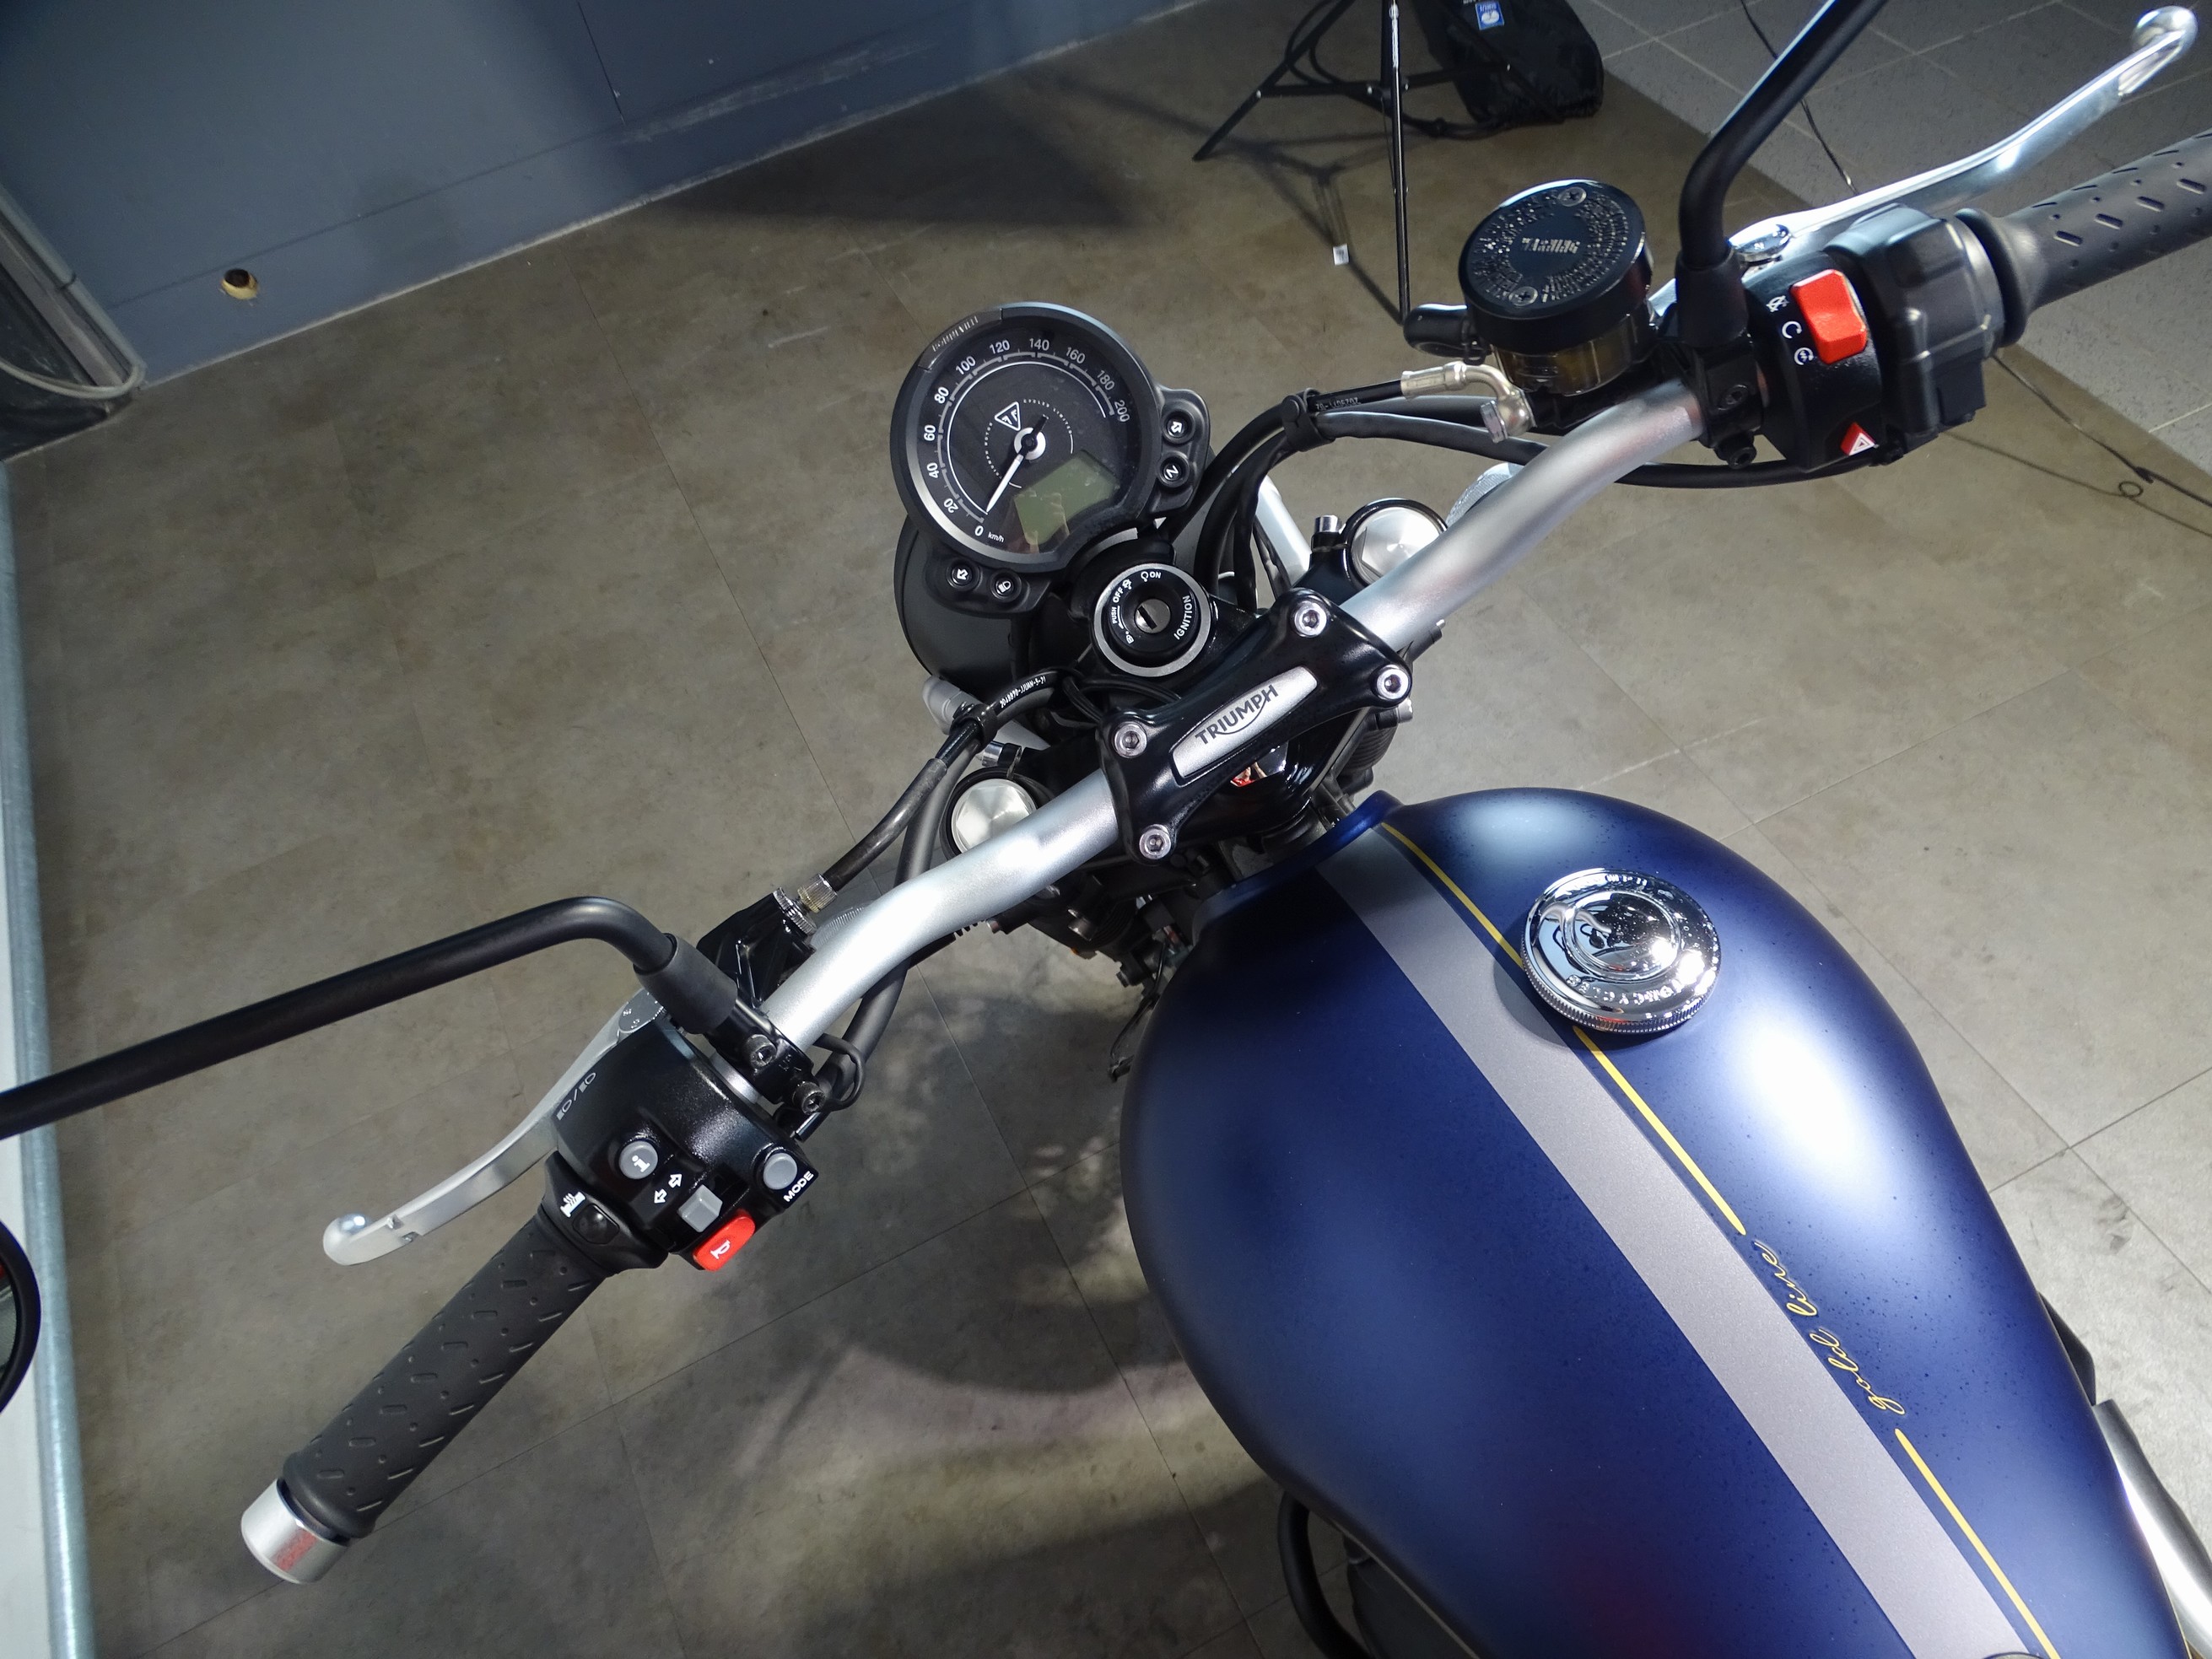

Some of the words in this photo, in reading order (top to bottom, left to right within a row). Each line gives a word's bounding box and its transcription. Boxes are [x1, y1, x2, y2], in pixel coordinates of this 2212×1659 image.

[989, 340, 1011, 354] 120
[1028, 338, 1050, 351] 140
[1065, 347, 1086, 364] 160
[955, 356, 976, 376] 100
[1096, 369, 1115, 391] 180
[934, 386, 950, 404] 80
[1114, 400, 1130, 423] 200
[924, 425, 936, 441] 60
[927, 462, 939, 479] 40
[943, 498, 958, 514] 20
[974, 525, 984, 536] 0
[988, 531, 1005, 543] km/h
[1113, 587, 1123, 603] OFF
[1173, 595, 1193, 640] IGNITION
[1195, 684, 1279, 745] TRIUMPH
[783, 1171, 814, 1203] MODE
[1754, 1241, 1818, 1317] line
[1810, 1328, 1906, 1415] gold
